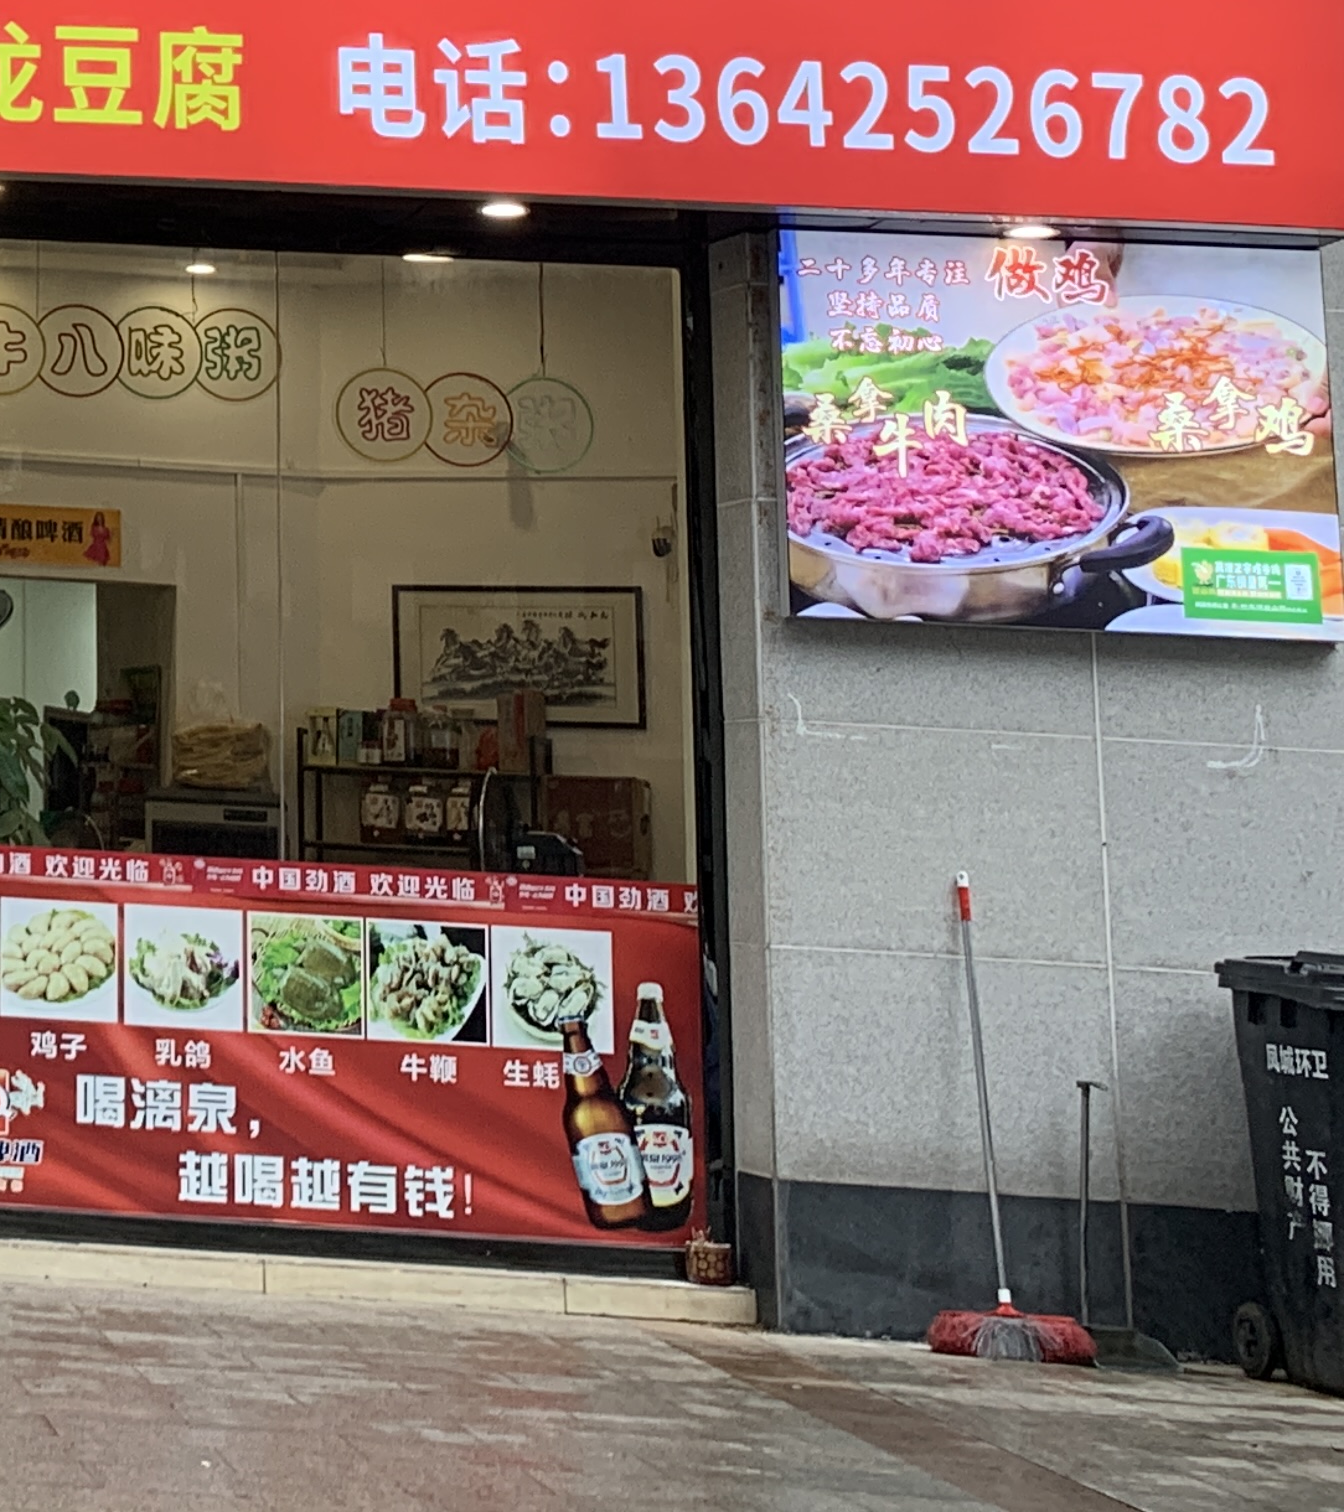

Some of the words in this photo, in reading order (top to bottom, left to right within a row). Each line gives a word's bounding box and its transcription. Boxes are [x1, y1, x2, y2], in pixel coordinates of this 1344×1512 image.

[796, 254, 970, 287] 二十多年专注
[985, 245, 1111, 306] 做鸡
[826, 289, 942, 323] 坚持品质
[829, 326, 944, 355] 不忘初心
[803, 374, 970, 479] 桑拿牛肉
[1150, 375, 1316, 457] 桑拿鸡
[45, 854, 149, 884] 欢迎光临
[252, 864, 356, 895] 中国劲酒
[369, 873, 476, 902] 欢迎光临
[564, 882, 670, 913] 中国劲酒
[30, 1031, 87, 1061] 鸡子
[155, 1038, 211, 1069] 乳鸽
[278, 1046, 336, 1076] 水鱼
[1266, 1043, 1330, 1080] 凤城环卫
[400, 1053, 457, 1084] 牛鞭
[503, 1059, 561, 1090] 生蚝
[1279, 1105, 1305, 1241] 公共财产
